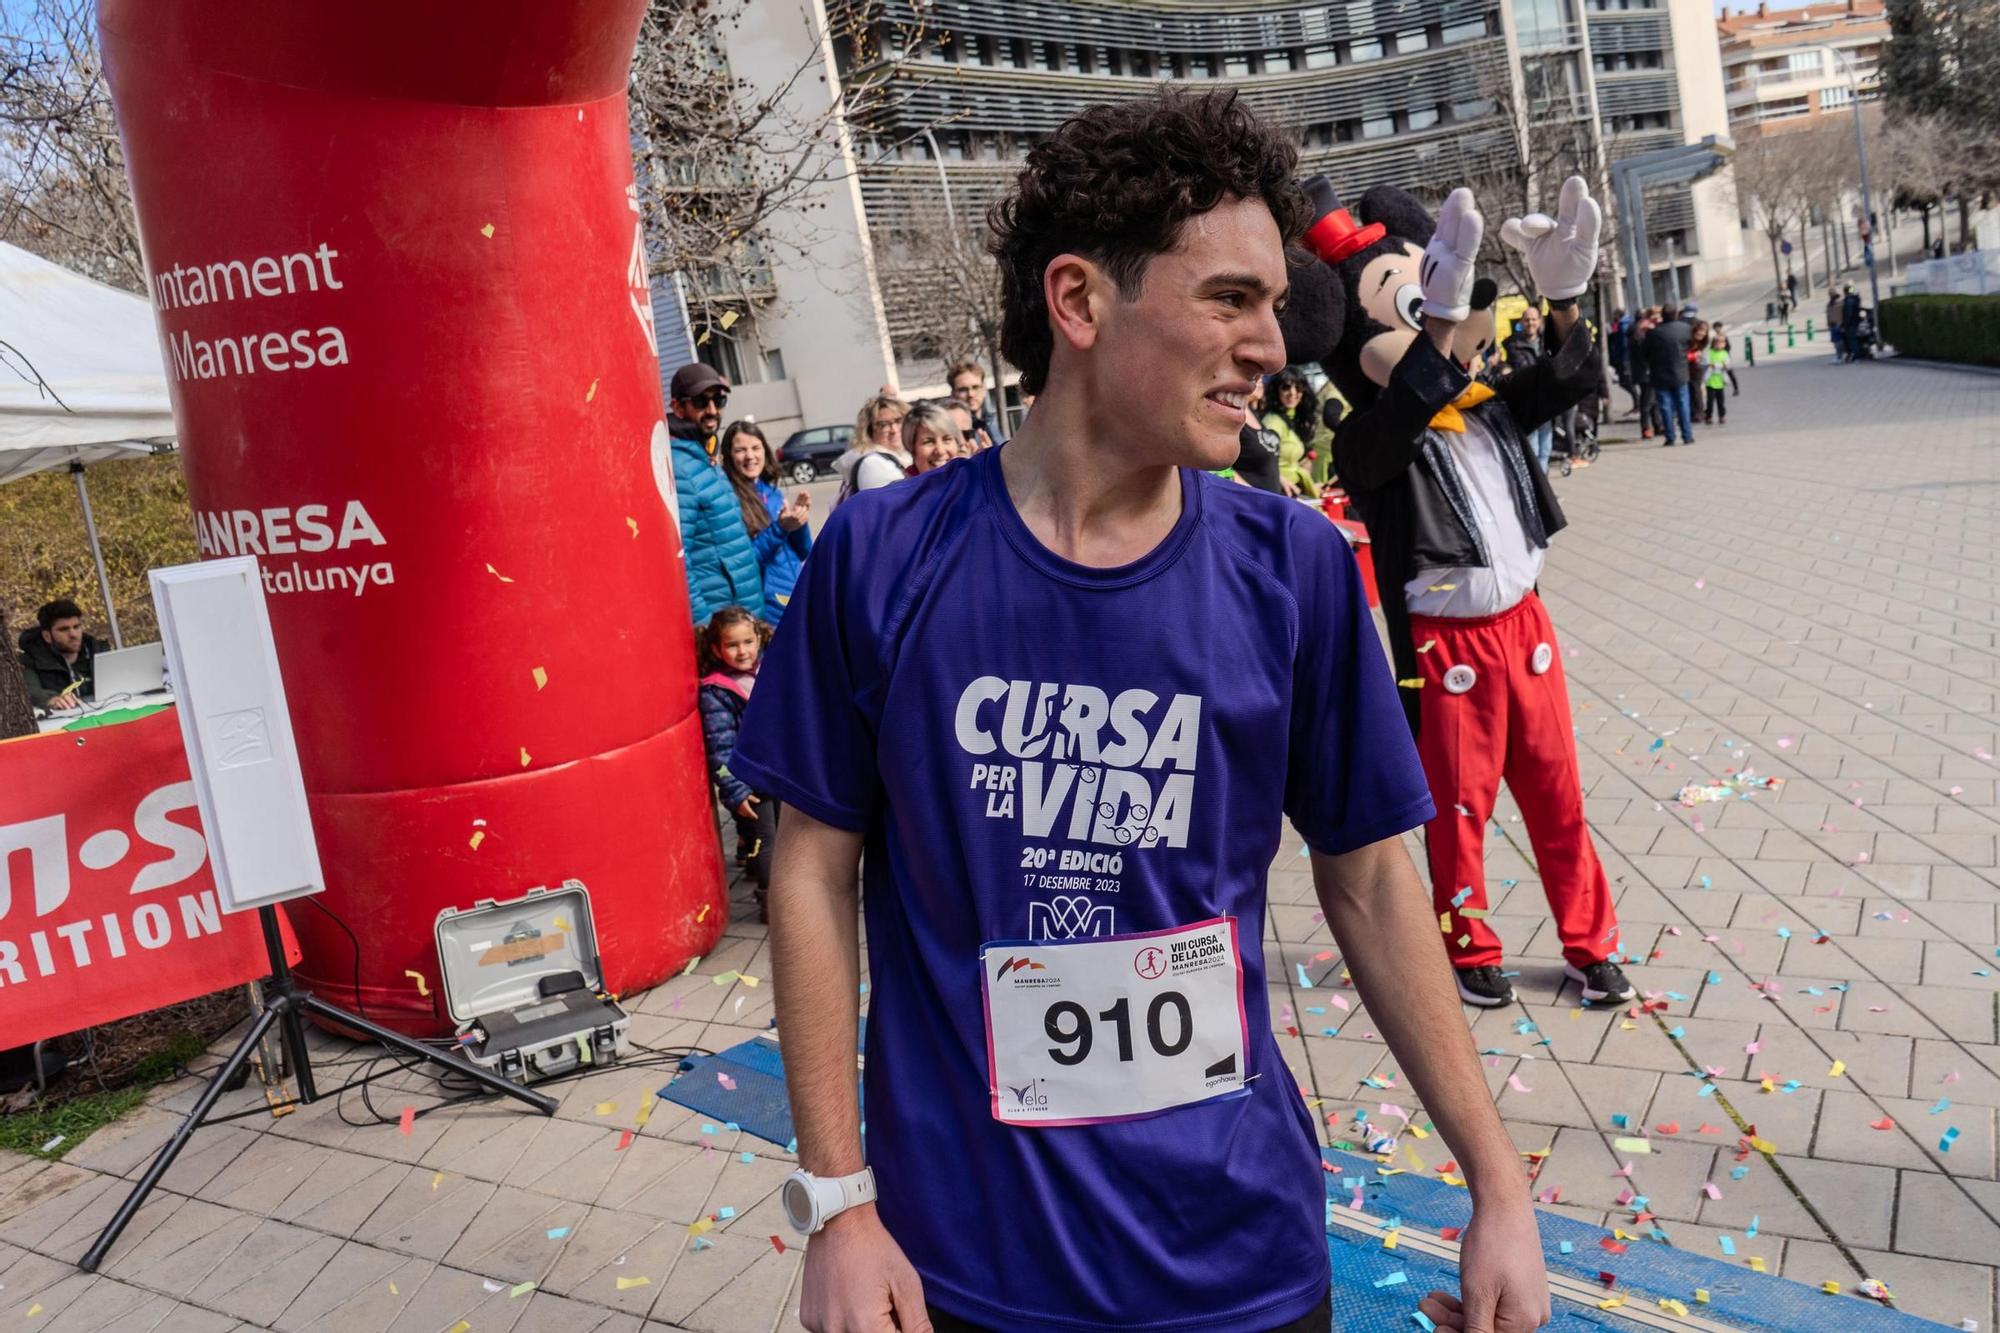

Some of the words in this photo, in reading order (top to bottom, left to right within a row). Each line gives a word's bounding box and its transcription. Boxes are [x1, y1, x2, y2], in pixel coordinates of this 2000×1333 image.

[169, 325, 350, 382] Manresa
[261, 561, 395, 597] talunya
[954, 675, 1202, 771] CURSA
[969, 763, 1018, 792] PER
[985, 792, 1015, 819] LA
[1021, 760, 1196, 849] VIDA
[1020, 846, 1057, 869] 20ª
[1058, 850, 1124, 876] EDICIÓ
[1023, 874, 1037, 887] 17
[1038, 875, 1092, 890] DESEMBRE
[1094, 878, 1121, 893] 2023
[0, 890, 223, 988] RITION
[1170, 941, 1187, 953] VIII
[1188, 934, 1218, 950] CURSA
[1171, 952, 1185, 963] DE
[1186, 949, 1198, 961] LA
[1199, 942, 1226, 958] DONA
[1044, 990, 1193, 1067] 910
